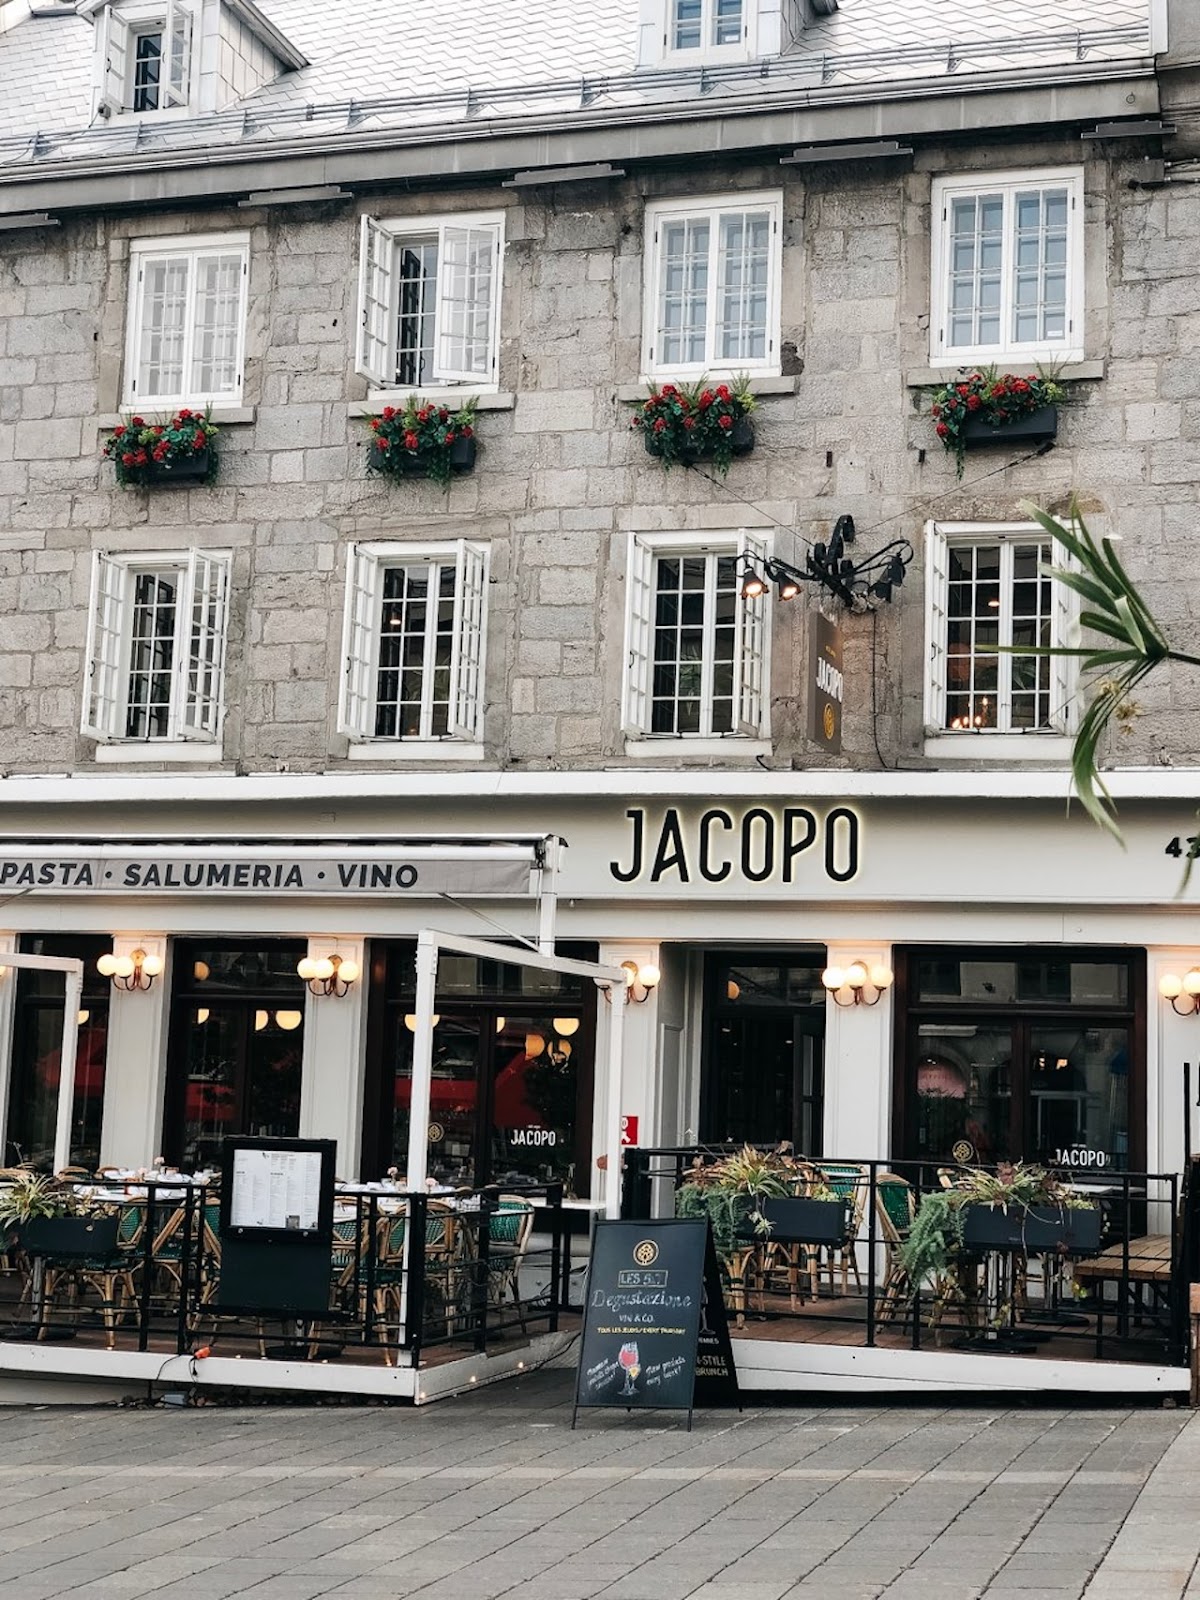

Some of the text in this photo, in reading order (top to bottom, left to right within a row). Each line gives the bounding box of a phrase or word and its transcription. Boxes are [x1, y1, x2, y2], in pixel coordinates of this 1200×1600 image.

[610, 808, 860, 883] JACOPO
[0, 862, 418, 888] PASTA SALUMERIA VINO
[510, 1129, 556, 1146] JACOPO
[1055, 1148, 1105, 1167] JACOPO
[621, 1273, 640, 1285] LES
